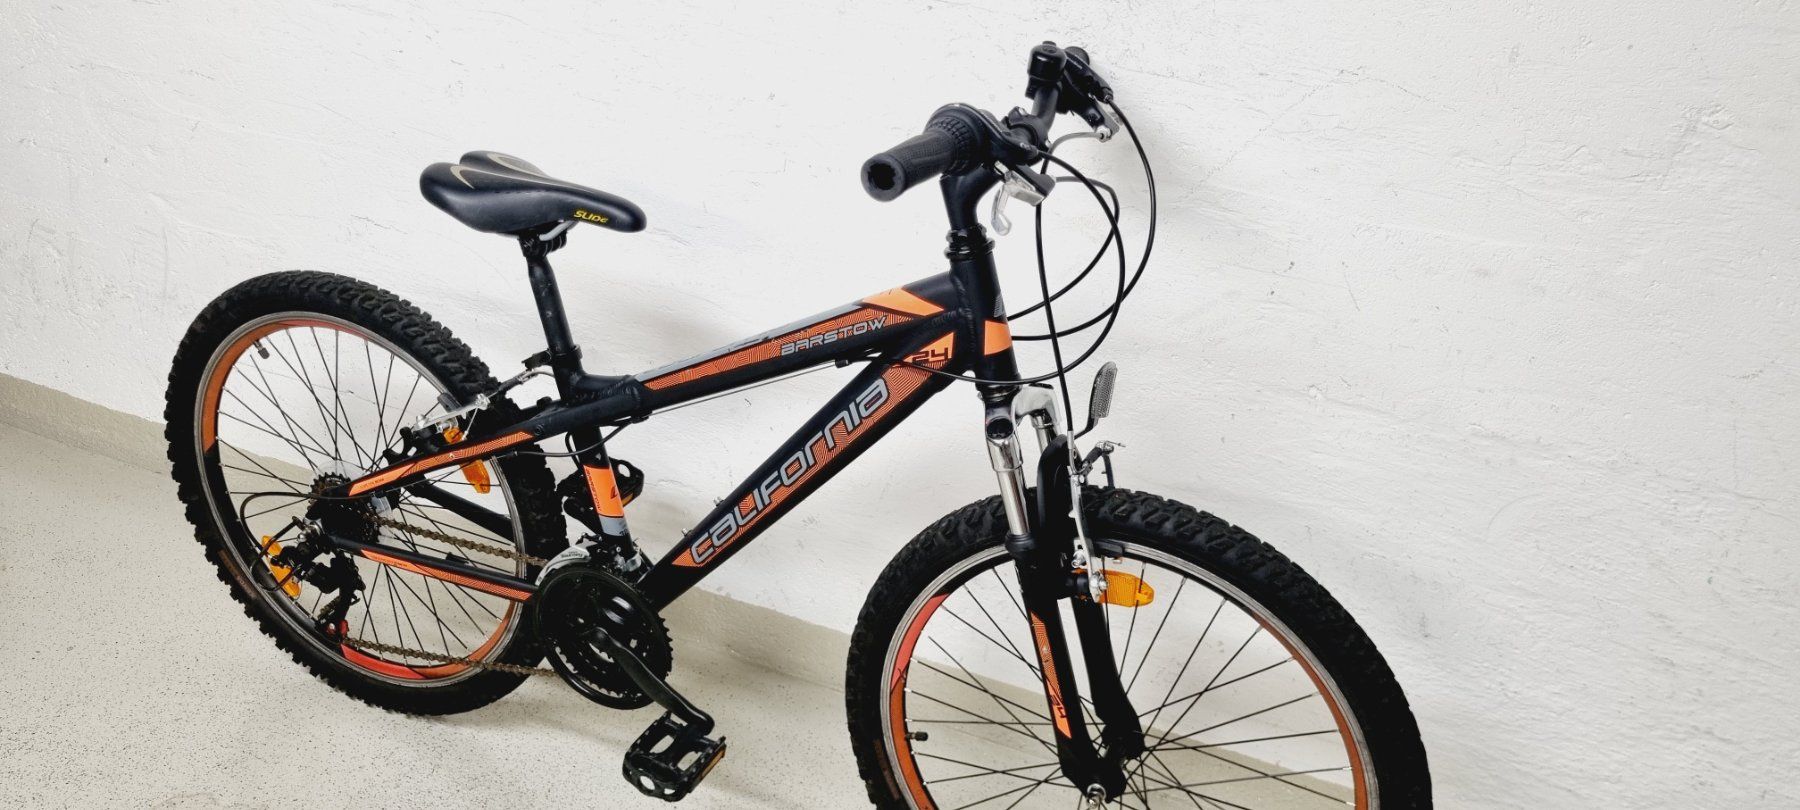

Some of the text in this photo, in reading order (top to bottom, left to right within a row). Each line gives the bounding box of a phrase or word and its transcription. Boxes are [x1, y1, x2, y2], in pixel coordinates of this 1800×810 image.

[573, 210, 609, 223] SLIDE
[781, 315, 887, 356] BARSTOW
[912, 347, 949, 364] 24
[690, 378, 888, 564] CALIFORNIA
